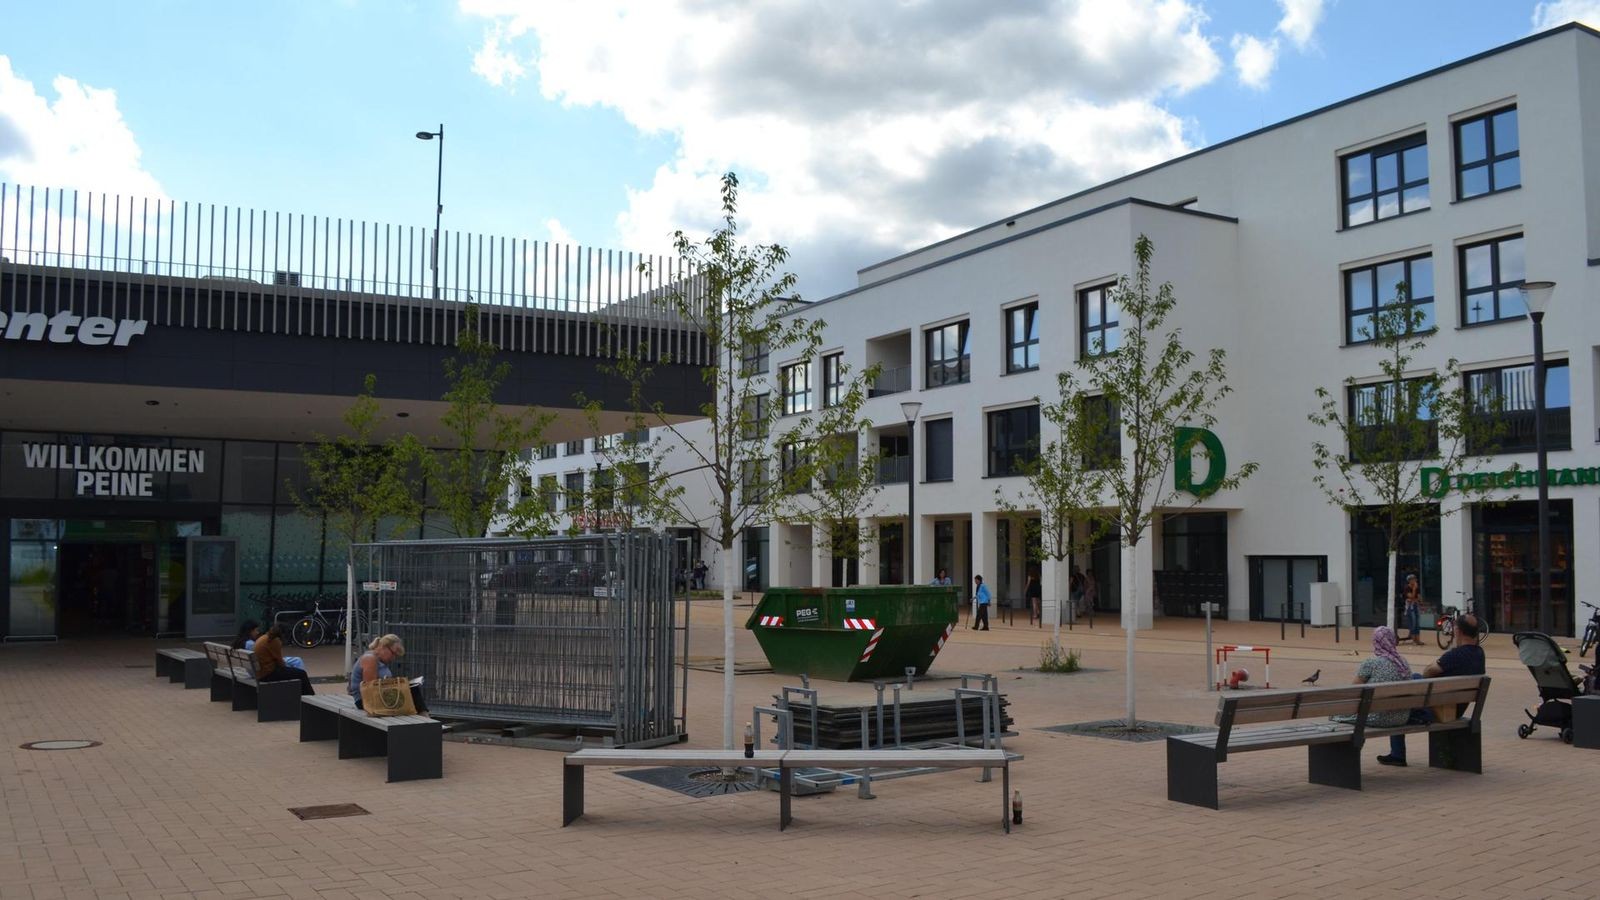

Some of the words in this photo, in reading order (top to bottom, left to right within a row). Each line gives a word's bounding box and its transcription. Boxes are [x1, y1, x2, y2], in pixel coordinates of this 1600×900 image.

[0, 310, 148, 346] nter
[22, 443, 205, 473] WILLKOMMEN
[1174, 427, 1227, 498] D
[77, 471, 153, 497] PEINE
[1457, 467, 1600, 489] DEICHMAN
